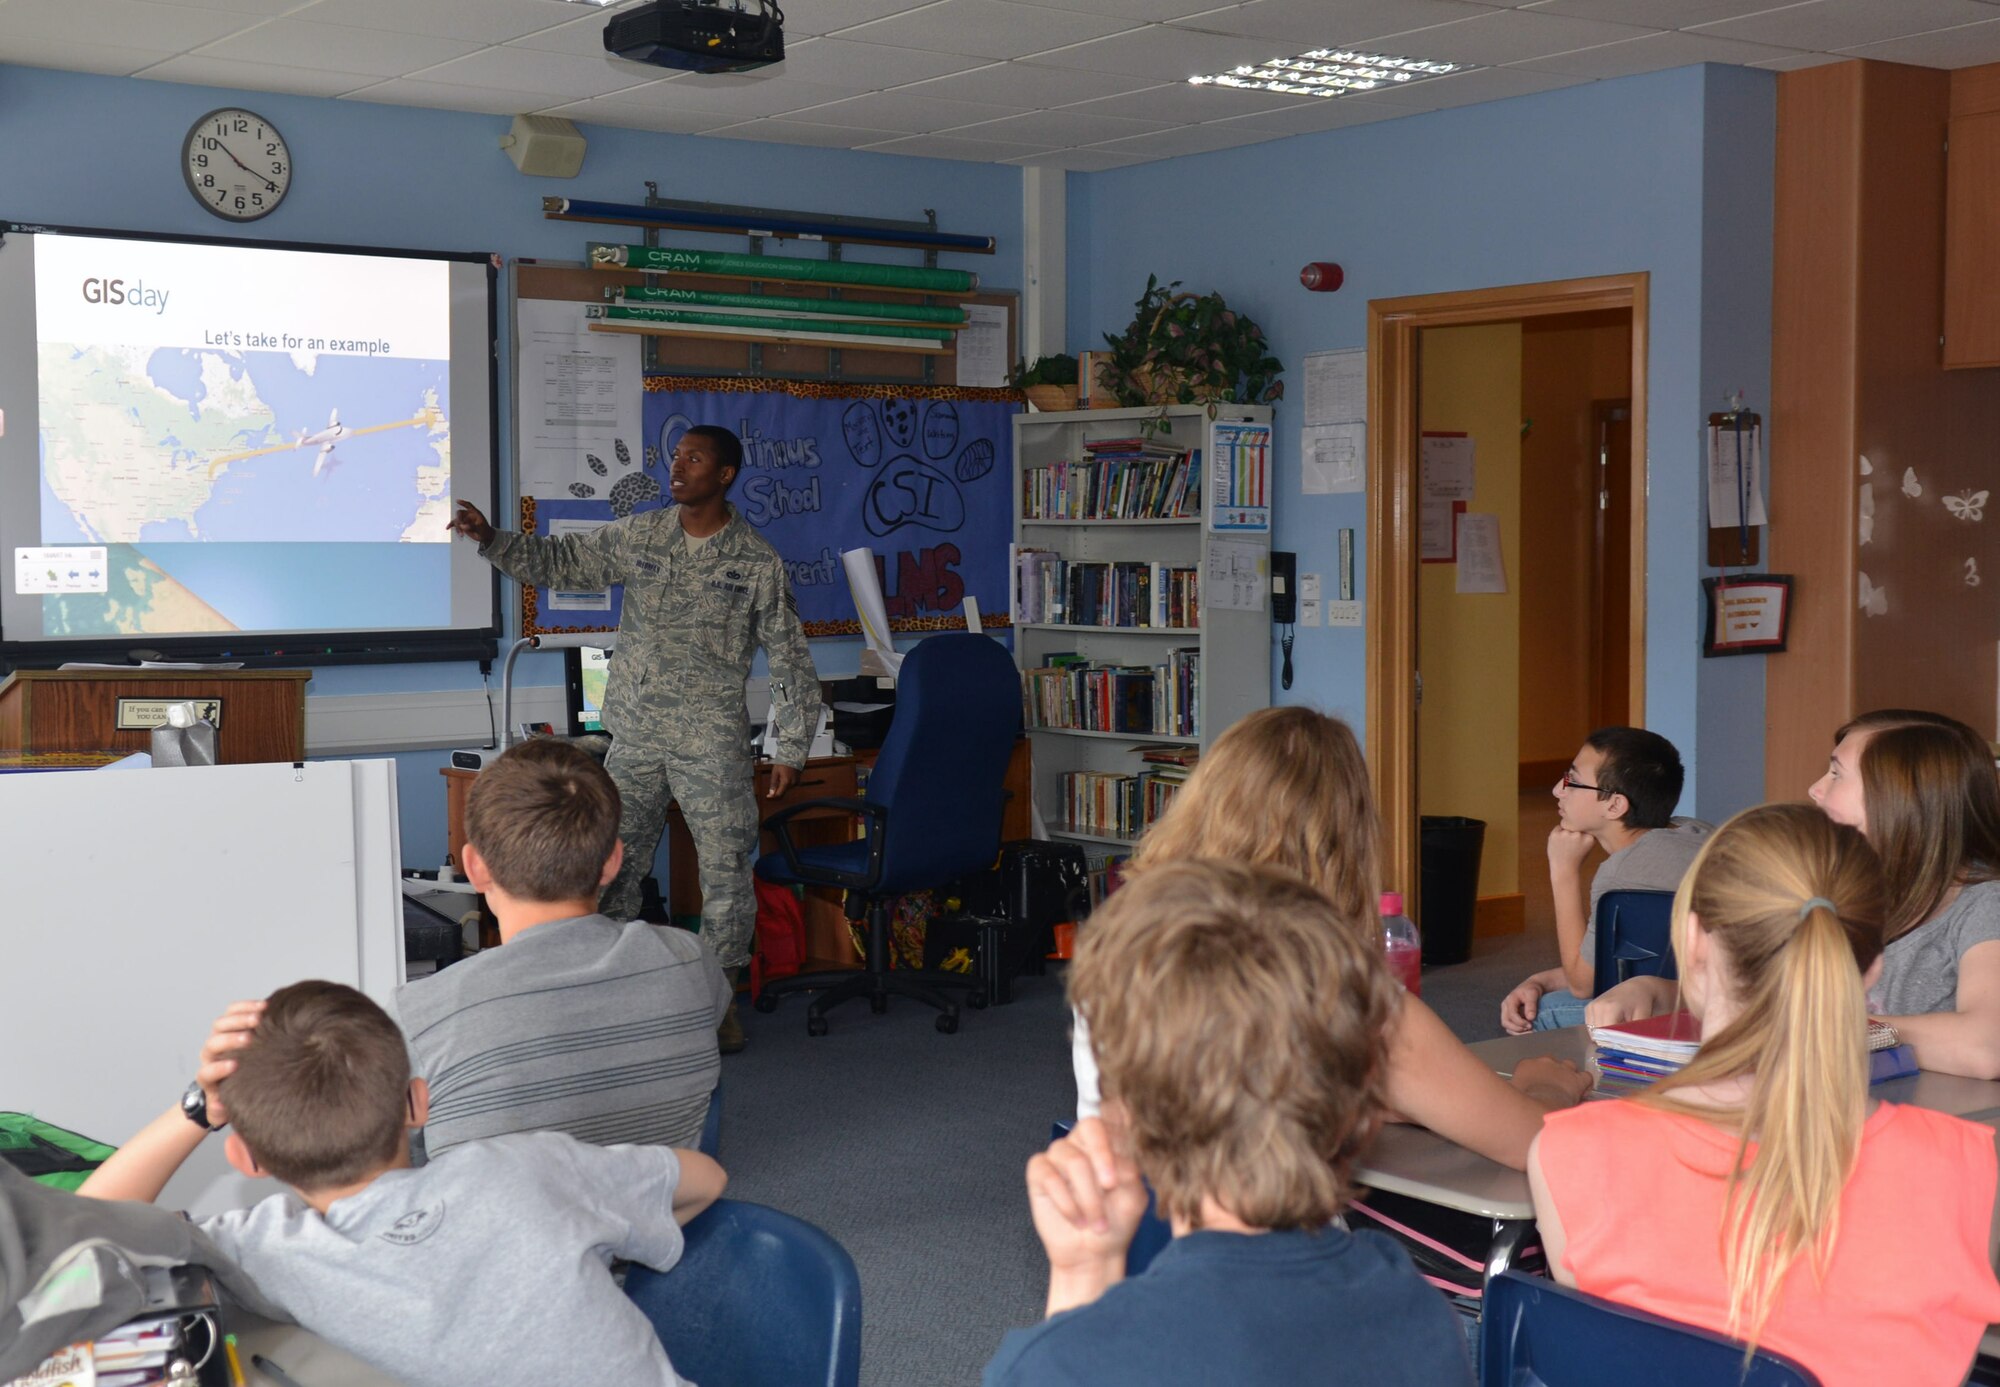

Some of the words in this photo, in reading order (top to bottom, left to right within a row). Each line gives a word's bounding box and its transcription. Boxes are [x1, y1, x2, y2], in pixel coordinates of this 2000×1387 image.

[217, 123, 227, 136] 11
[234, 120, 248, 133] 12
[257, 128, 262, 140] 1
[203, 137, 218, 150] 10
[266, 143, 276, 156] 2
[197, 154, 208, 167] 9
[271, 161, 282, 174] 3
[204, 174, 214, 187] 8
[265, 181, 276, 193] 4
[217, 189, 227, 202] 7
[252, 193, 263, 205] 5
[234, 196, 245, 209] 6
[648, 250, 700, 264] CRAM
[644, 287, 696, 299] CRAM
[205, 329, 241, 347] Let's
[246, 332, 277, 348] take
[282, 333, 303, 349] for
[307, 337, 325, 350] an
[330, 338, 390, 356] example
[743, 475, 822, 528] School
[872, 470, 944, 526] CSI
